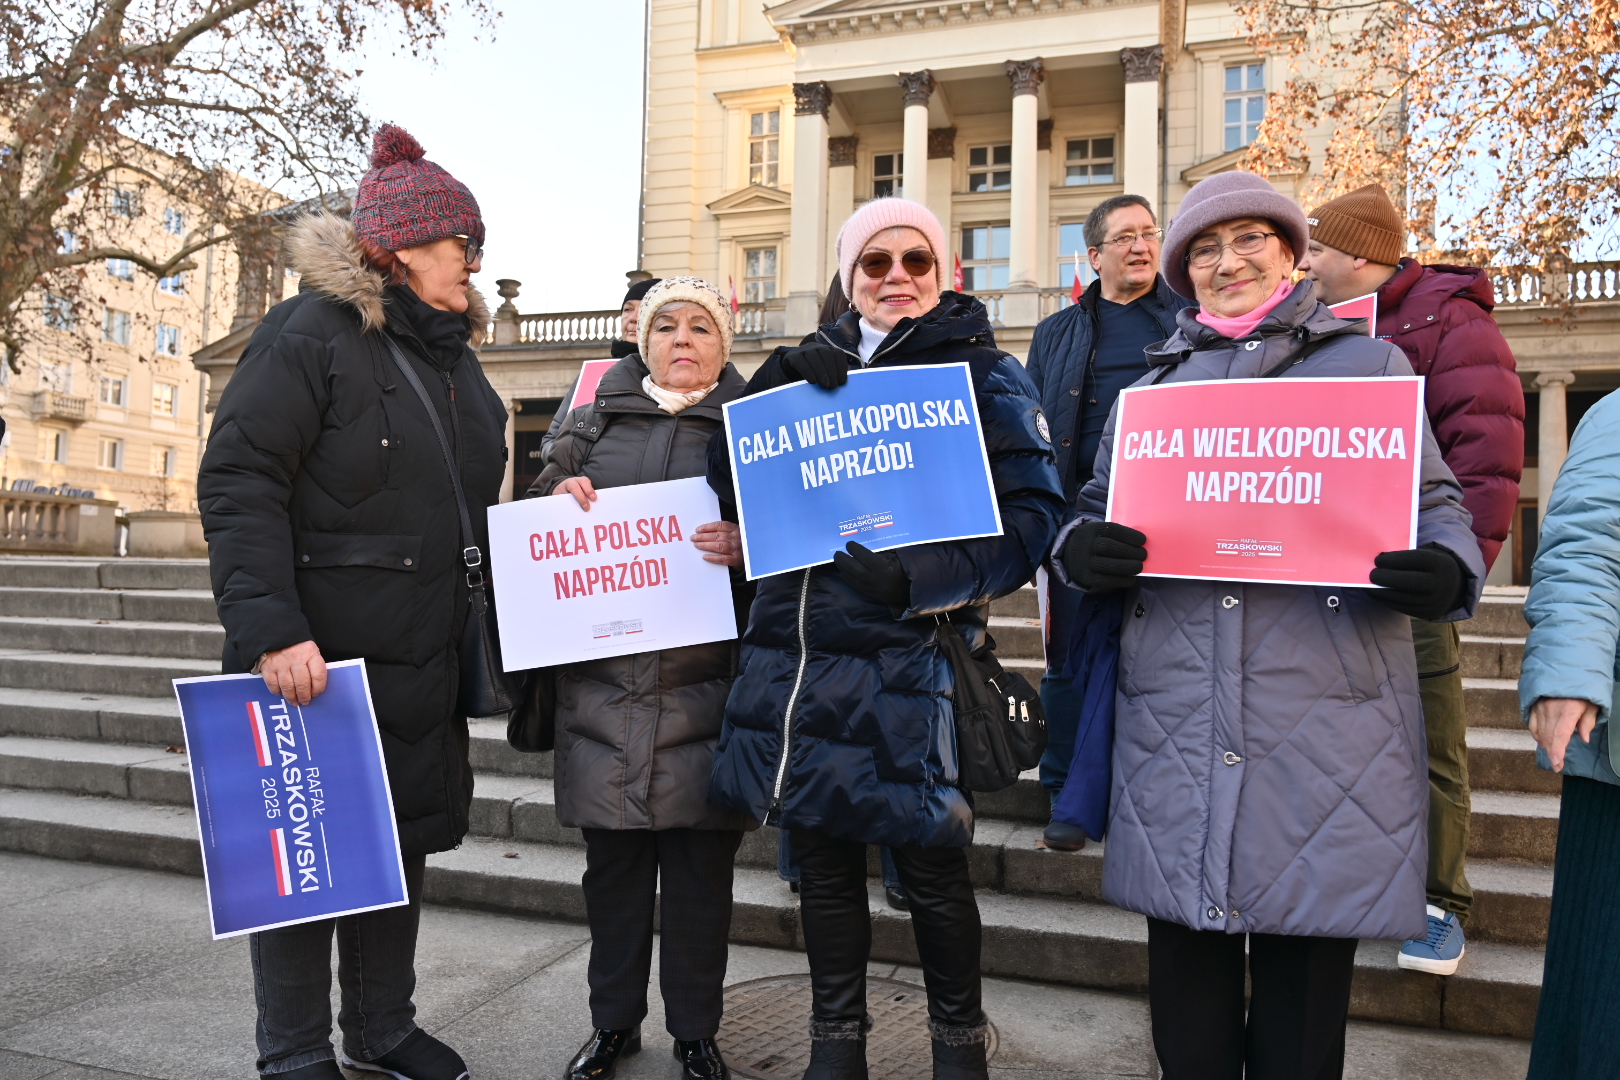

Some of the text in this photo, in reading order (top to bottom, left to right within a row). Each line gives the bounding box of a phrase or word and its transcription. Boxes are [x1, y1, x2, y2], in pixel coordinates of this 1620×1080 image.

[738, 398, 971, 465] CAŁA WIELKOPOLSKA
[1123, 426, 1407, 460] CAŁA WIELKOPOLSKA
[799, 439, 915, 491] NAPRZÓD!
[1185, 465, 1323, 505] NAPRZÓD!
[529, 514, 684, 562] CAŁA POLSKA
[838, 514, 893, 531] TRZASKOWSKI
[1215, 542, 1282, 552] TRZASKOWSKI
[553, 555, 669, 600] NAPRZÓD!
[261, 777, 281, 819] 2025
[268, 698, 320, 893] TRZASKOWSKI
[305, 766, 326, 819] RAFAŁ
